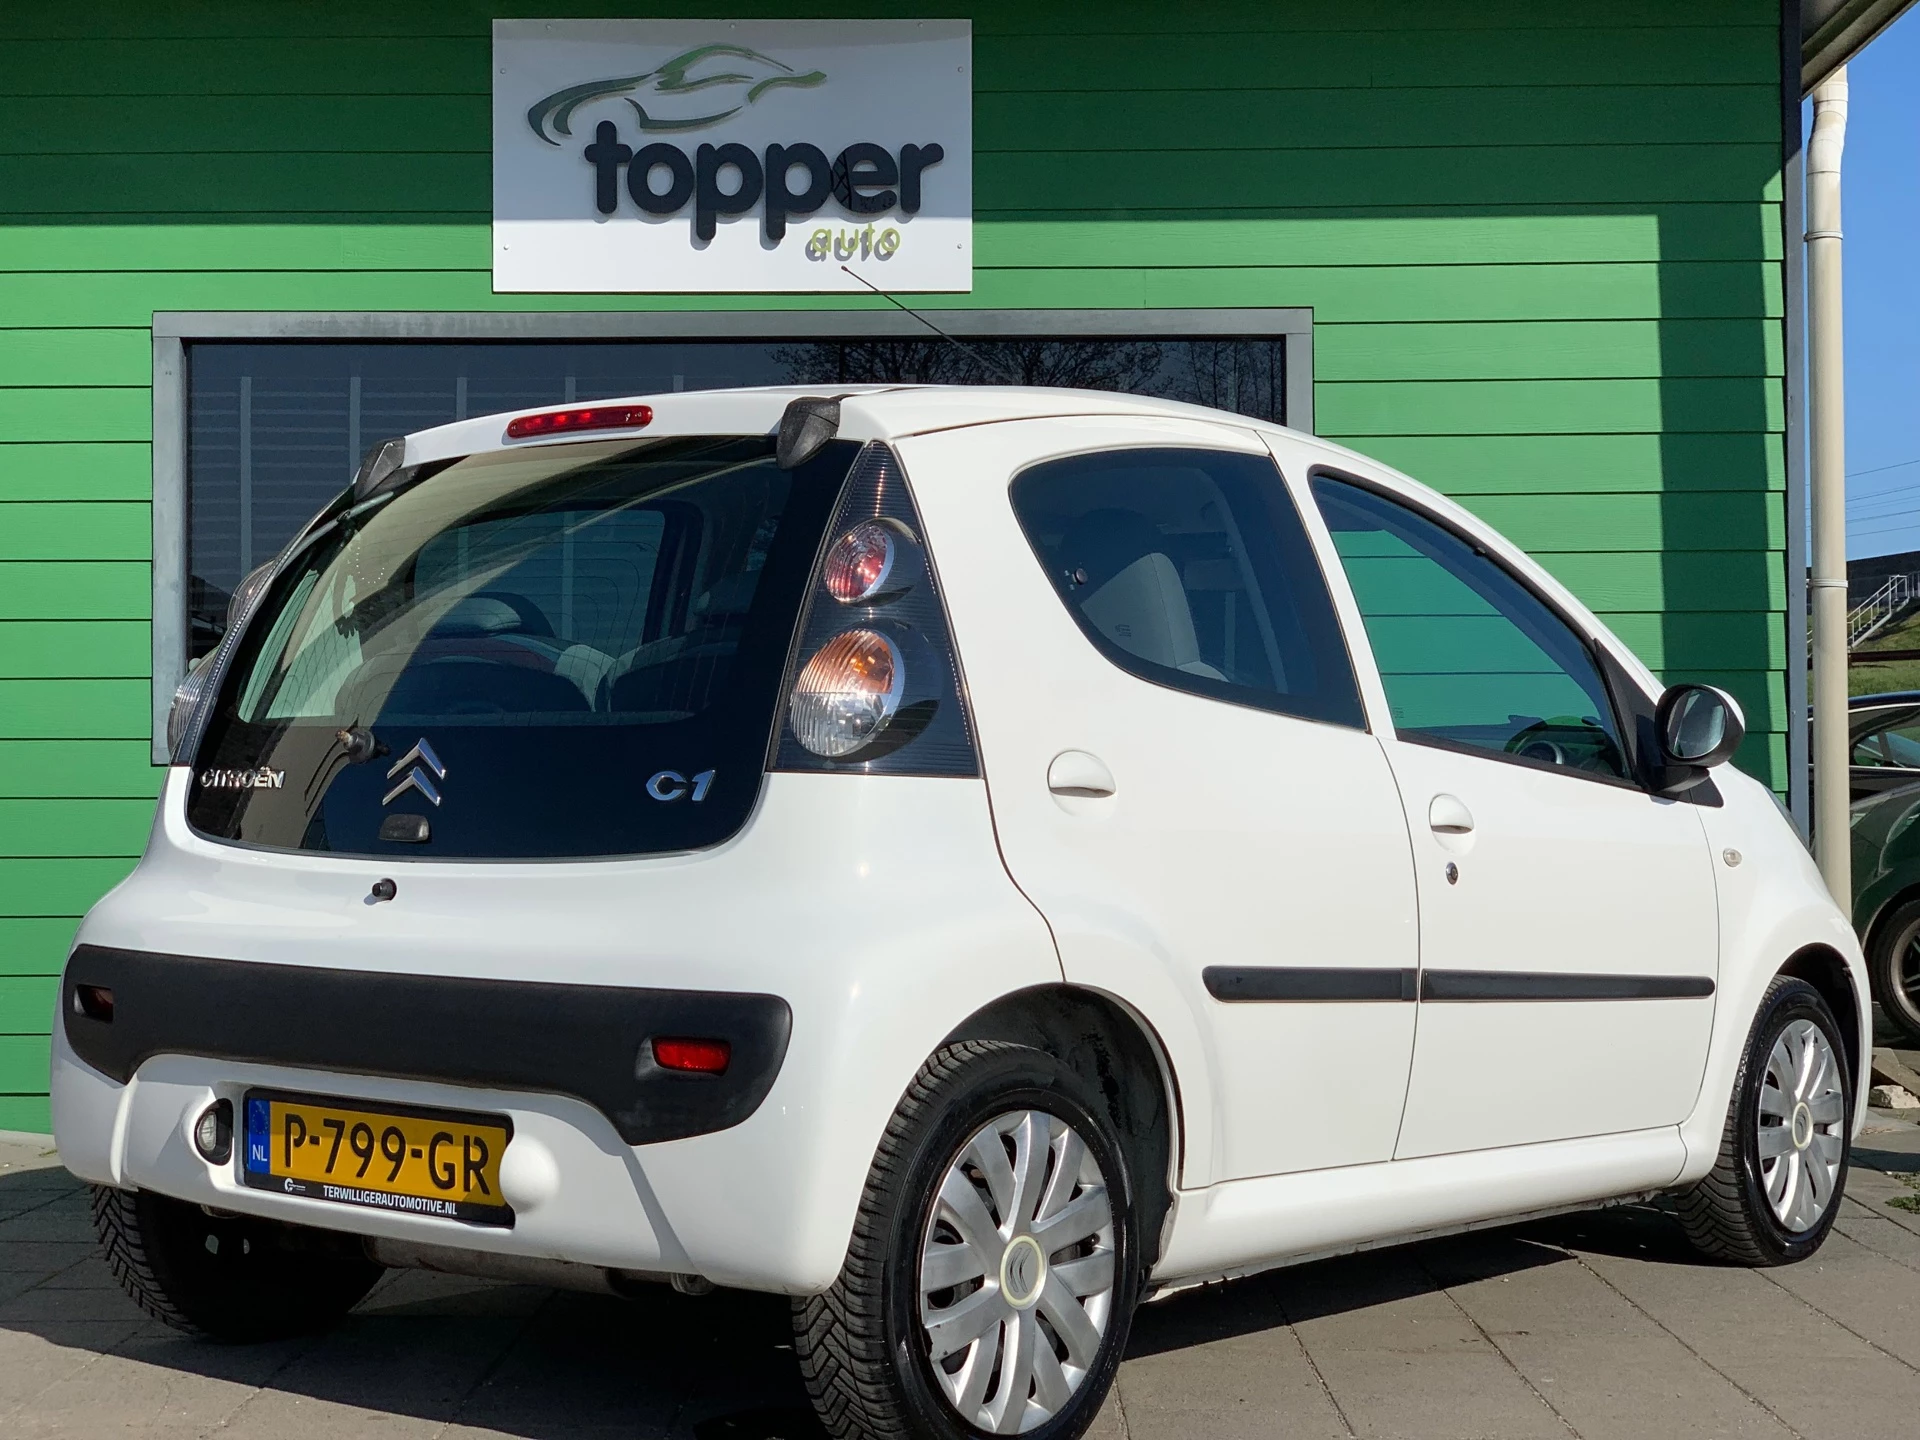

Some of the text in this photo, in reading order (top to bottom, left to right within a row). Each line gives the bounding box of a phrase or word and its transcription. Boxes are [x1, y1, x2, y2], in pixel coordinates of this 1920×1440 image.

[584, 120, 945, 241] topper
[811, 222, 901, 253] auto
[645, 769, 716, 802] C1
[252, 1144, 268, 1162] NL
[284, 1112, 491, 1196] P-799-GR
[323, 1184, 458, 1215] TERWILLIGERAUTOMOTIVE.NL
